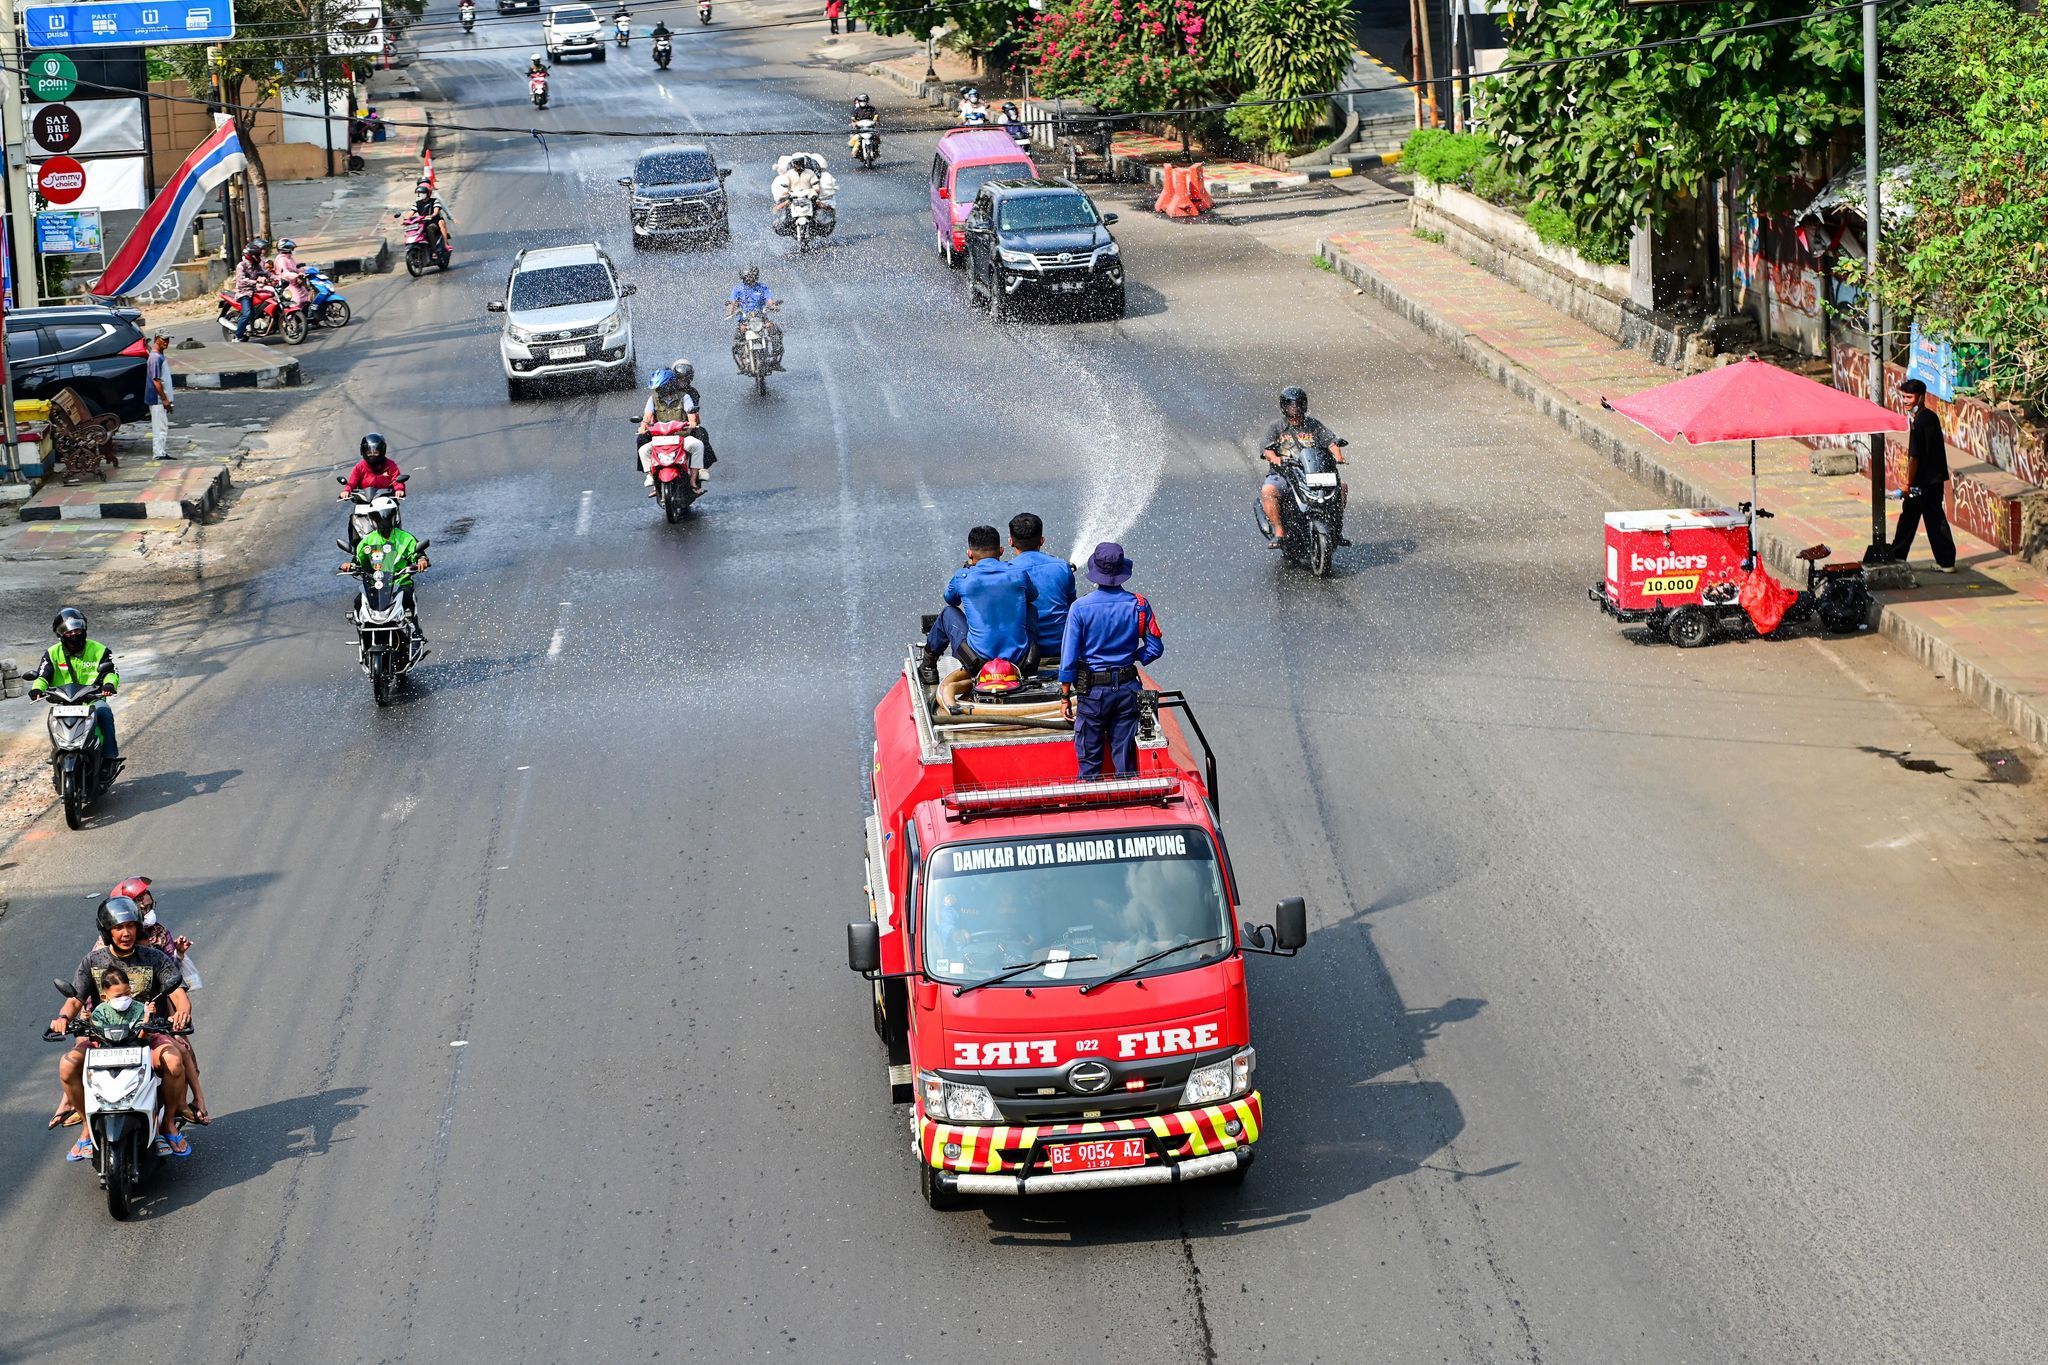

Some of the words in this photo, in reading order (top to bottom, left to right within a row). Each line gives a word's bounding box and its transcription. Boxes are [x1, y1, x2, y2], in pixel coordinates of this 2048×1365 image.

[46, 30, 69, 39] pulsa
[135, 24, 169, 35] payment
[46, 115, 68, 125] SAY
[46, 124, 70, 134] BRE
[47, 133, 64, 142] AD
[1631, 551, 1708, 575] kopiers
[1647, 579, 1694, 592] 10.000
[952, 847, 1015, 872] DAMKAR
[1017, 844, 1054, 866] KOTA
[1056, 839, 1116, 864] BANDAR
[1118, 834, 1187, 859] LAMPUNG
[1076, 1039, 1099, 1052] 022
[1117, 1023, 1219, 1058] FIRE
[1053, 1147, 1072, 1164] BE
[1078, 1143, 1114, 1161] 9054
[1123, 1141, 1141, 1157] AZ
